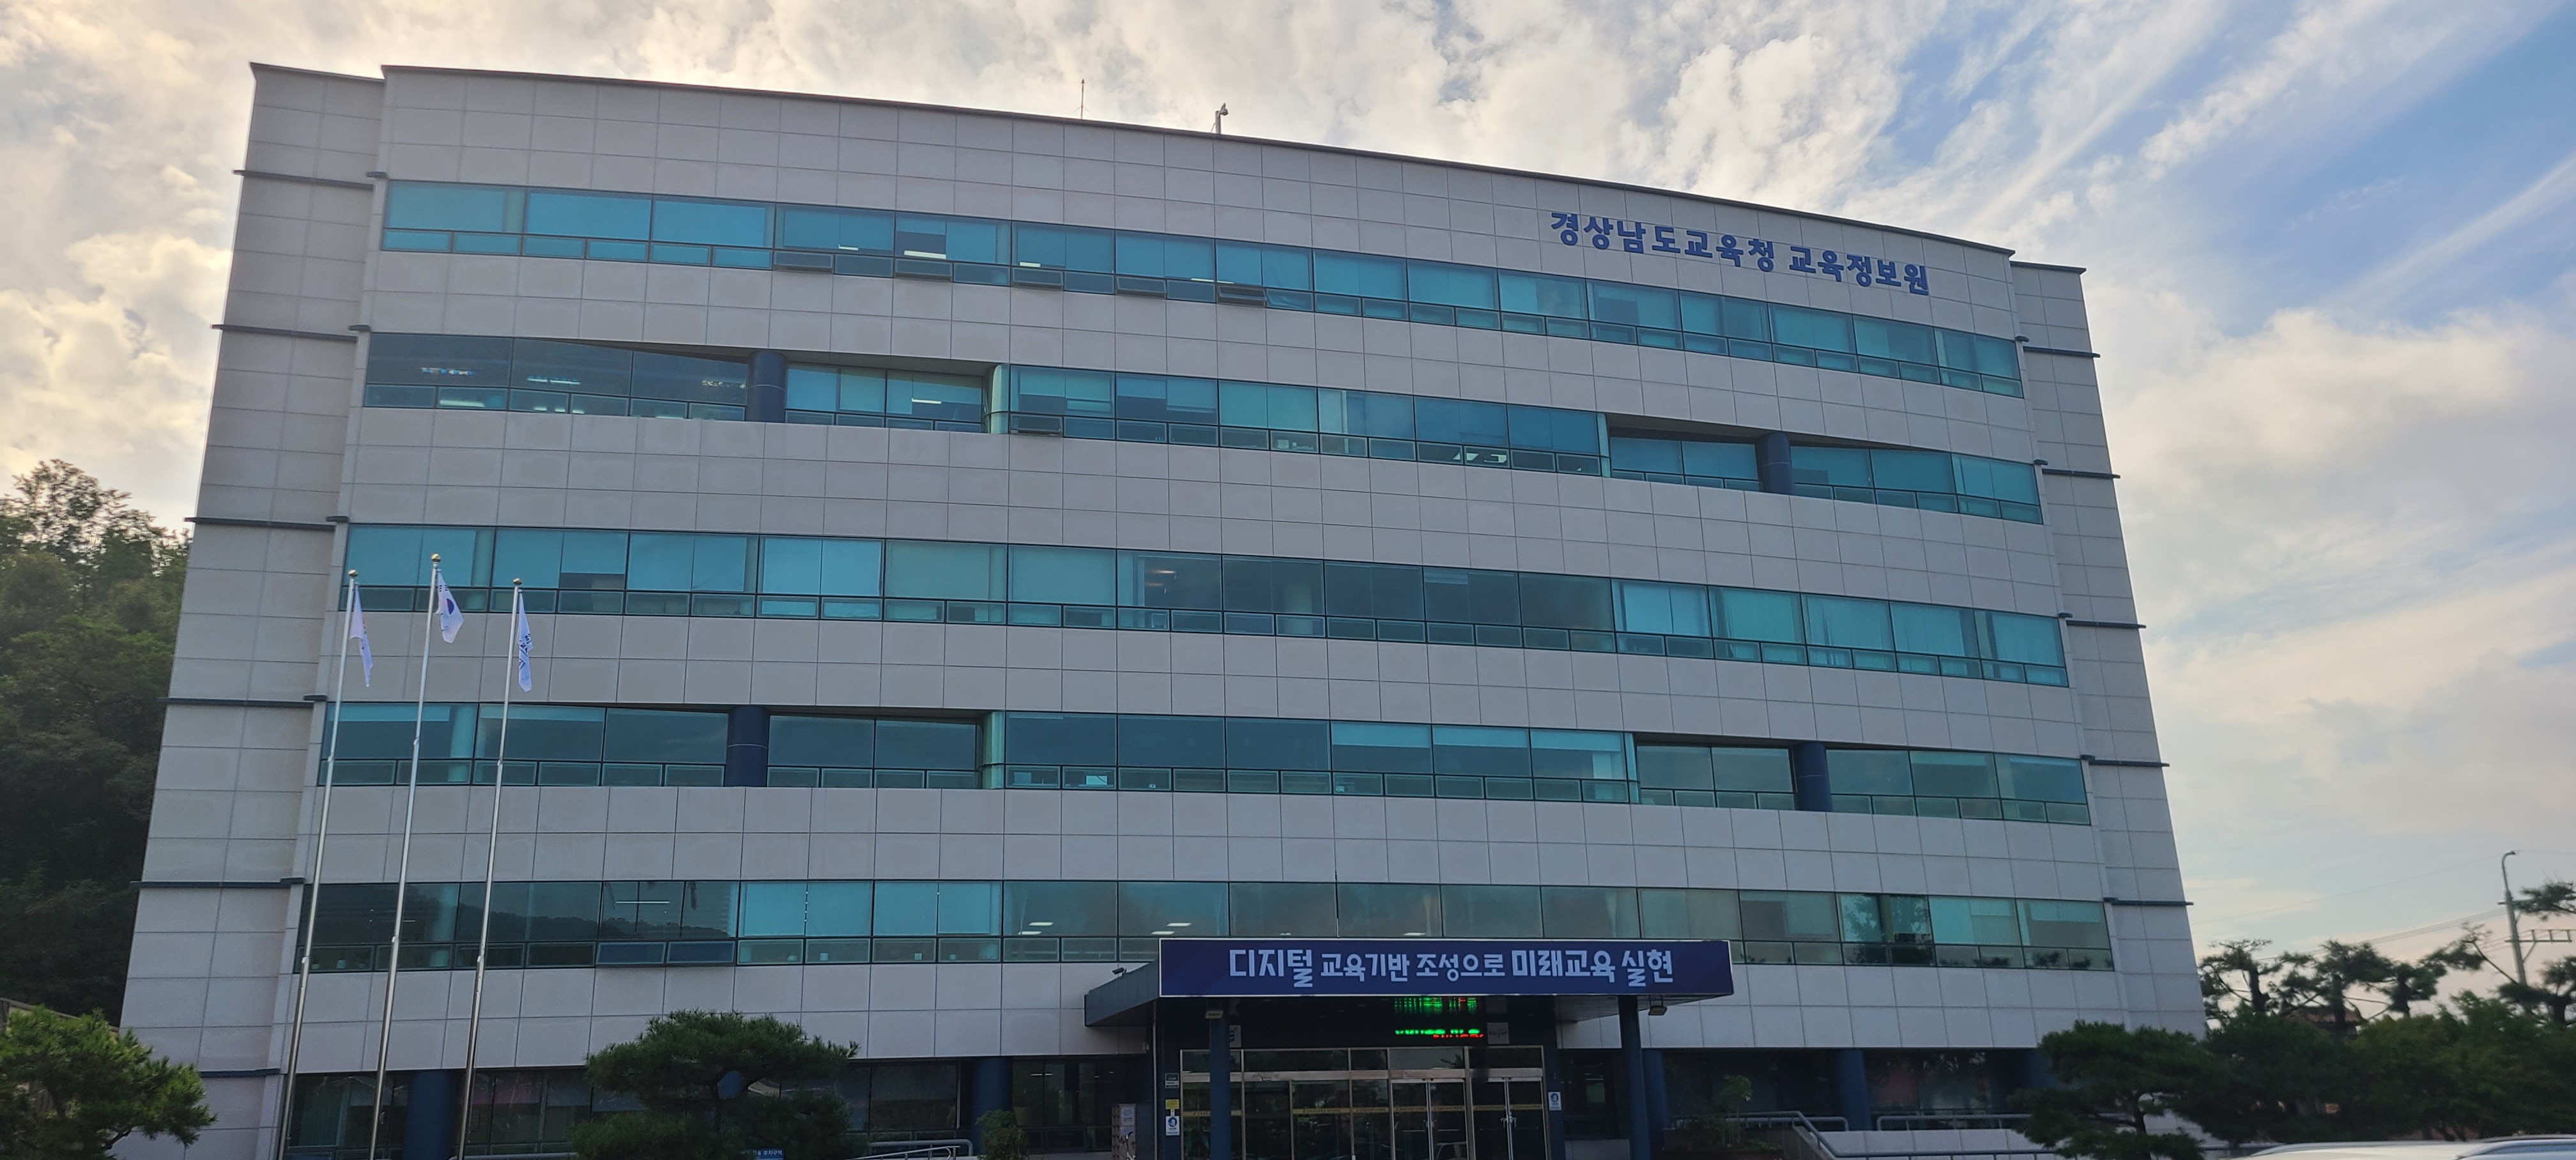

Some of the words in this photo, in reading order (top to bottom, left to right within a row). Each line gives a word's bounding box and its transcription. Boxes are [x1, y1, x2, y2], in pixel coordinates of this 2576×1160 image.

[1550, 211, 1774, 273] 경상남도교육청
[1789, 245, 1929, 296] 교육정보원
[1229, 949, 1313, 988] 디지털
[1320, 953, 1410, 982] 교육기반
[1416, 953, 1506, 982] 조성으로
[1511, 949, 1616, 983] 미래교육
[1621, 949, 1674, 987] 실현
